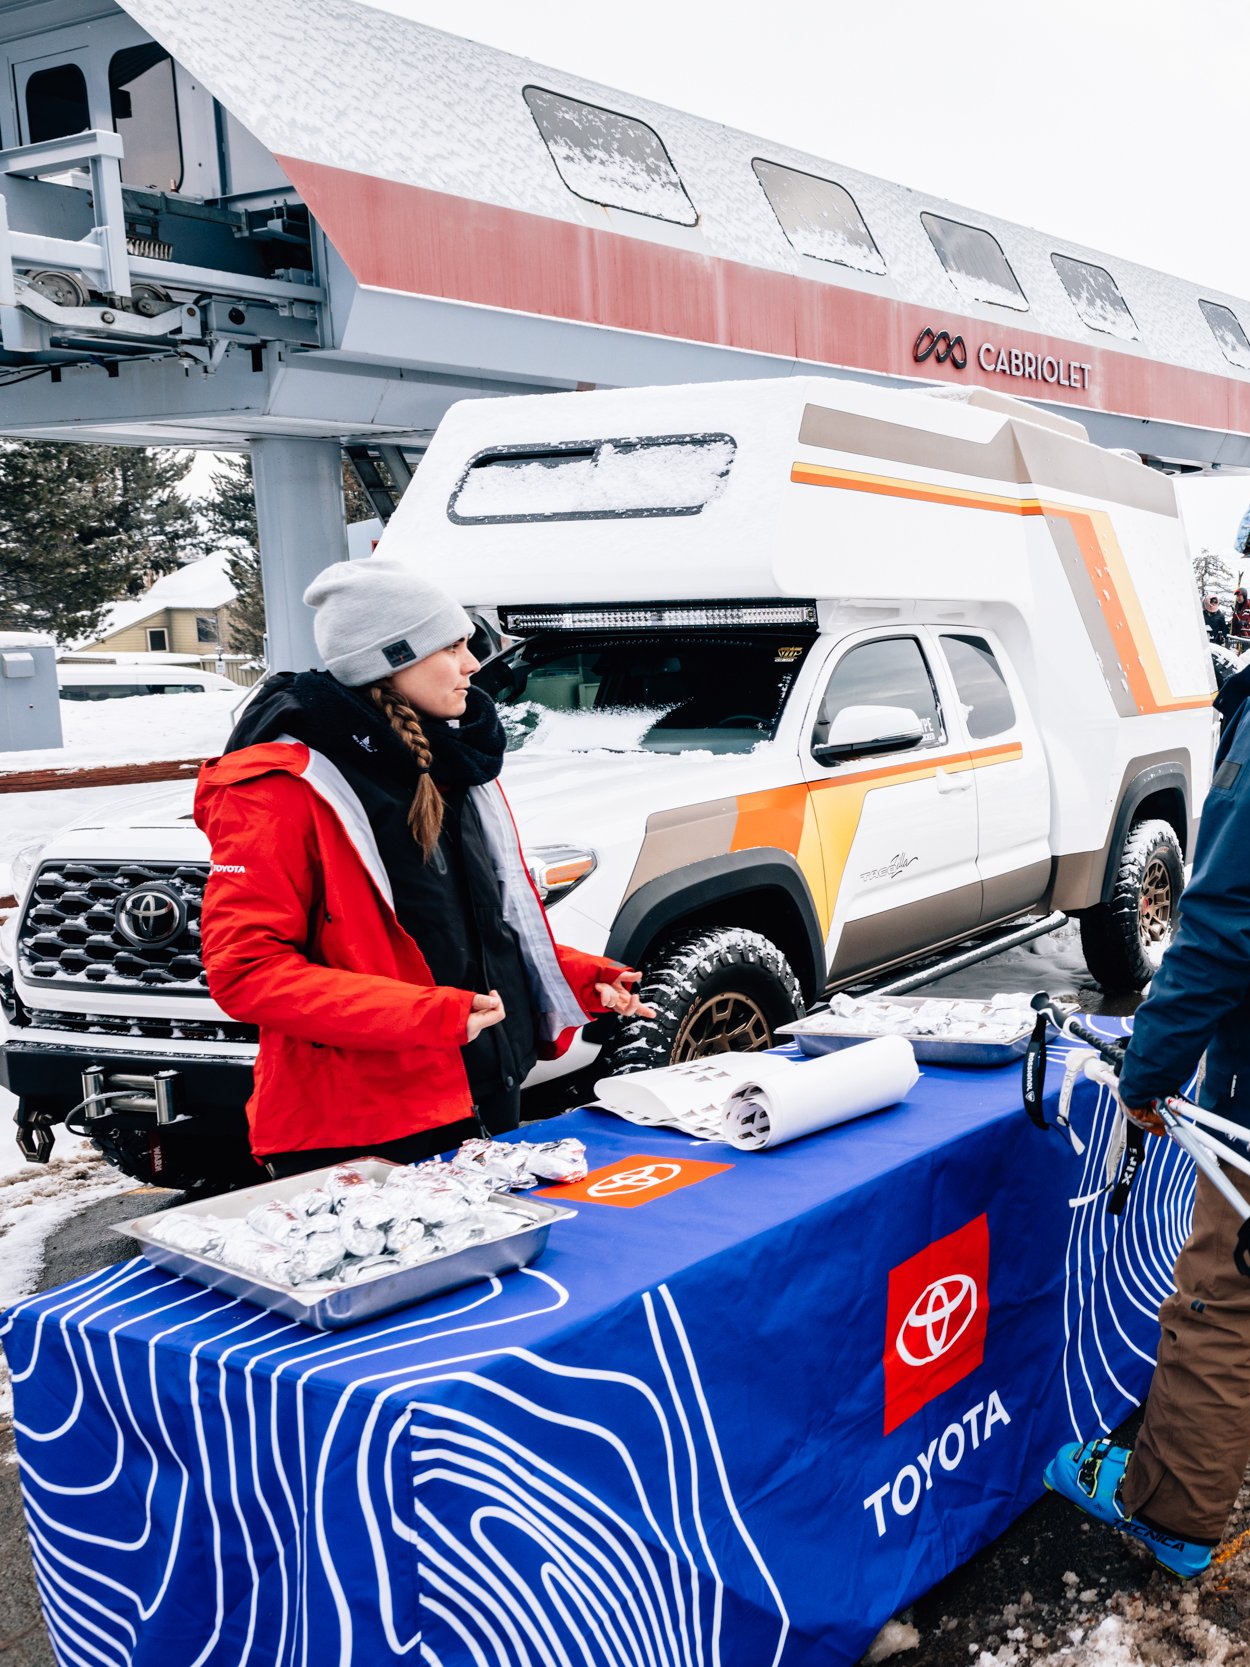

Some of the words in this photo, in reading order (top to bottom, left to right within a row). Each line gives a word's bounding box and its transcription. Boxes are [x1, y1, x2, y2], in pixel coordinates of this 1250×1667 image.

[978, 342, 1092, 390] CABRIOLET
[213, 864, 246, 874] TOYOTA
[153, 1145, 163, 1172] WARN
[863, 1389, 1011, 1538] TOYOTA
[1112, 1518, 1185, 1552] TECNICA
